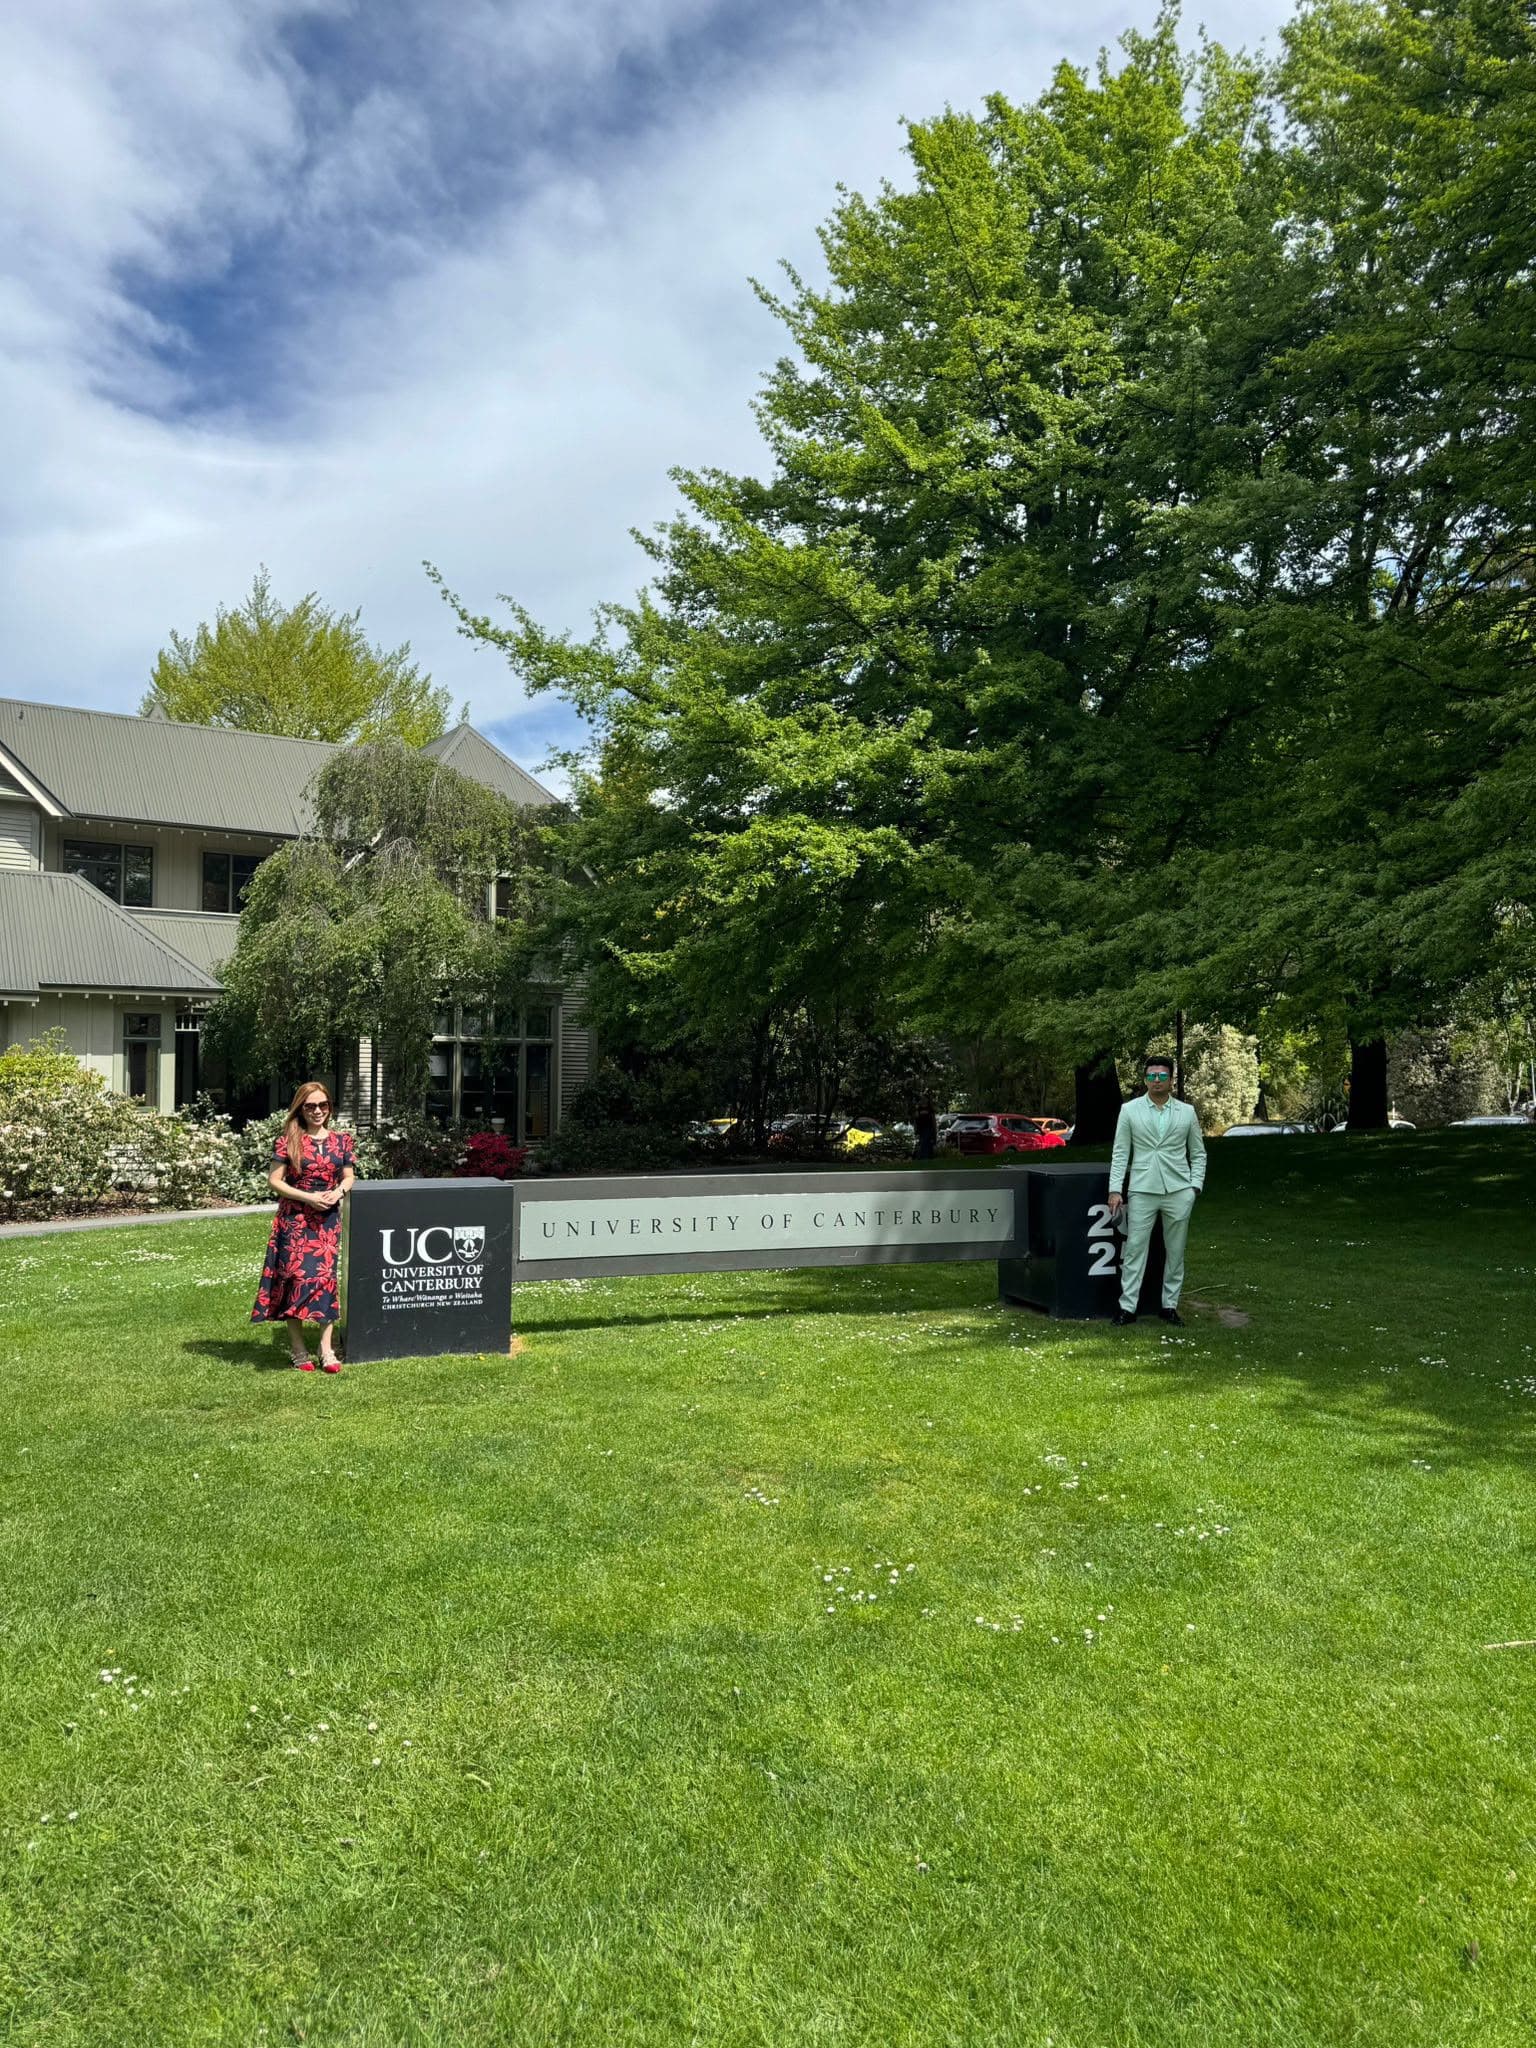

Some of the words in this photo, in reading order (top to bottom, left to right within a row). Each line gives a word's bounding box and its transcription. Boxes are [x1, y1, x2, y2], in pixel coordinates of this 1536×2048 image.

[542, 1215, 740, 1238] UNIVERSITY
[761, 1213, 793, 1230] OF
[813, 1208, 999, 1228] CANTERBURY
[379, 1226, 453, 1265] UC
[382, 1265, 465, 1279] UNIVERSITY
[466, 1264, 484, 1275] OF
[381, 1277, 484, 1293] CANTERBURY
[382, 1295, 390, 1303] Te
[382, 1302, 435, 1310] CHRISTCHURCH
